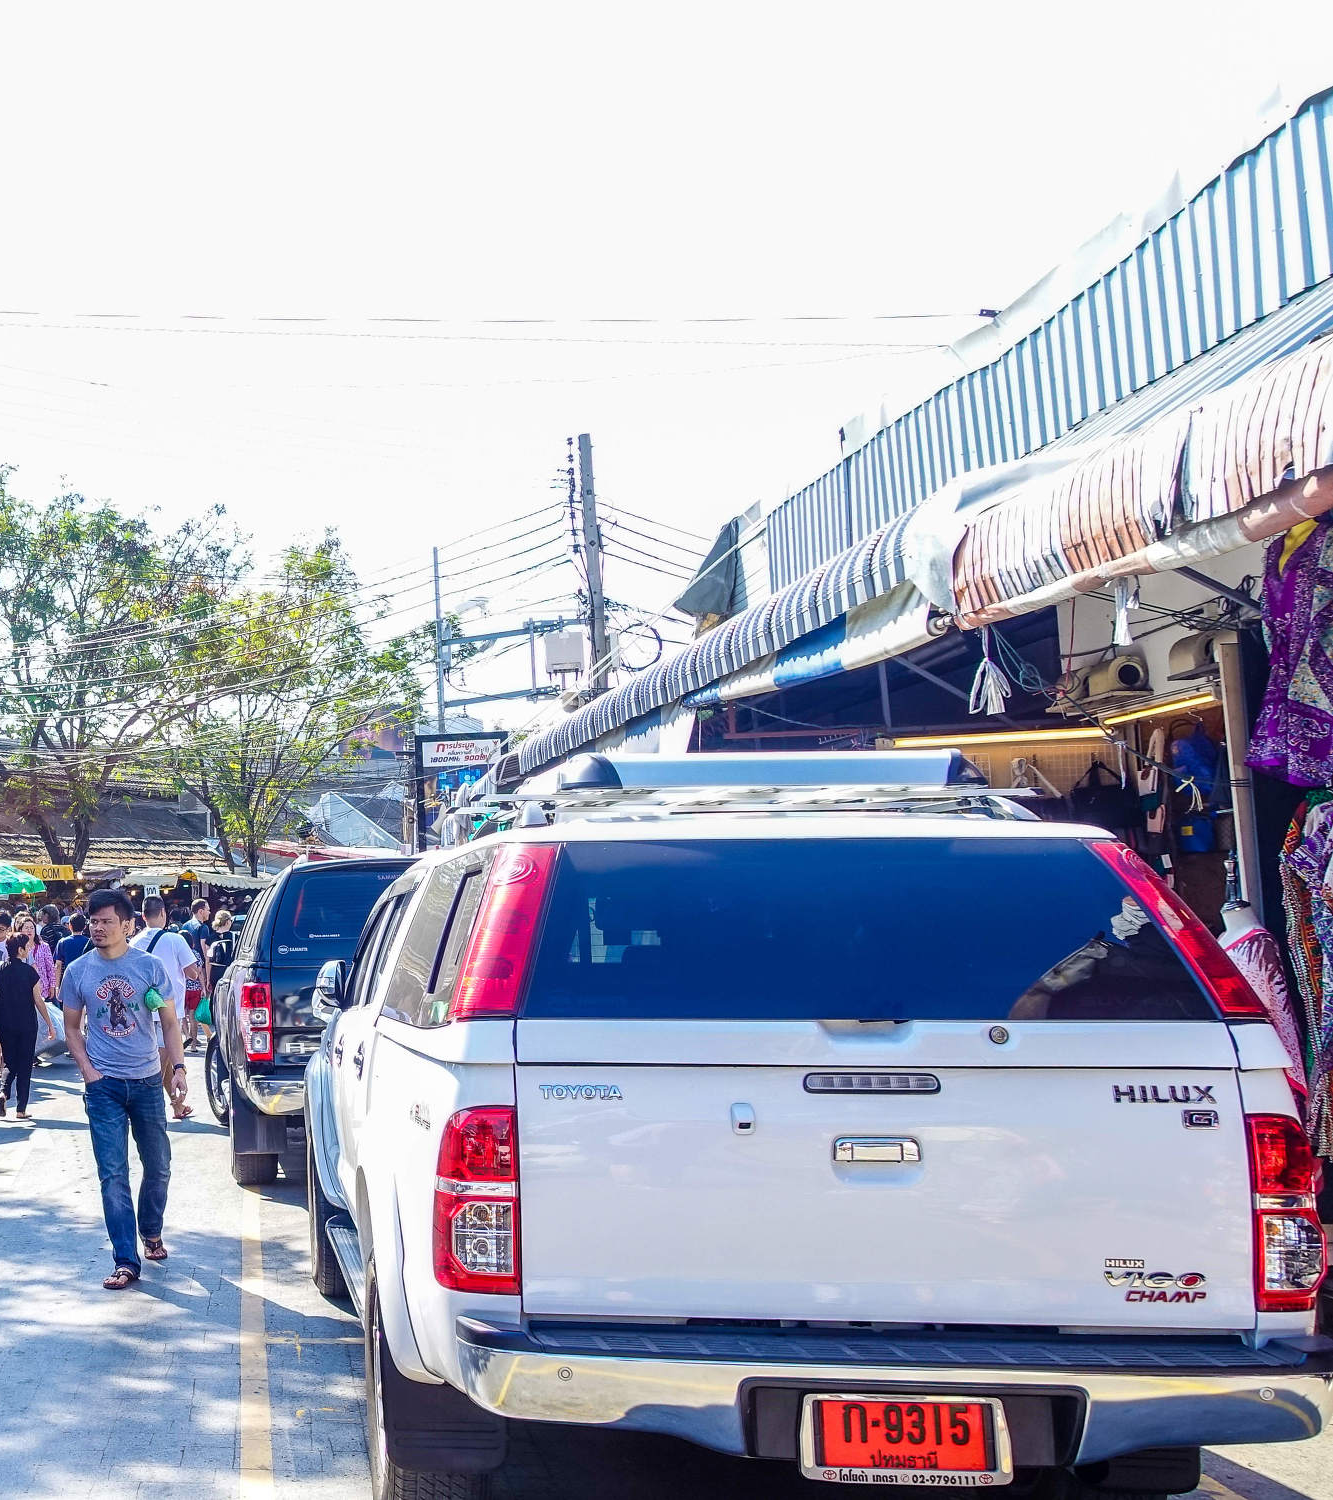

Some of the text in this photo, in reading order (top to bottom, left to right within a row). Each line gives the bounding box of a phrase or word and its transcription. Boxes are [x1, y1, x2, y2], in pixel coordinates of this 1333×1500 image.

[538, 1084, 623, 1101] TOYOTA
[1111, 1084, 1218, 1105] HILUX
[1104, 1259, 1145, 1269] HILUX
[1103, 1271, 1207, 1290] VIGO
[1124, 1290, 1207, 1303] CHAMP
[842, 1403, 971, 1446] ก-9315
[911, 1474, 977, 1486] 02-9796111
